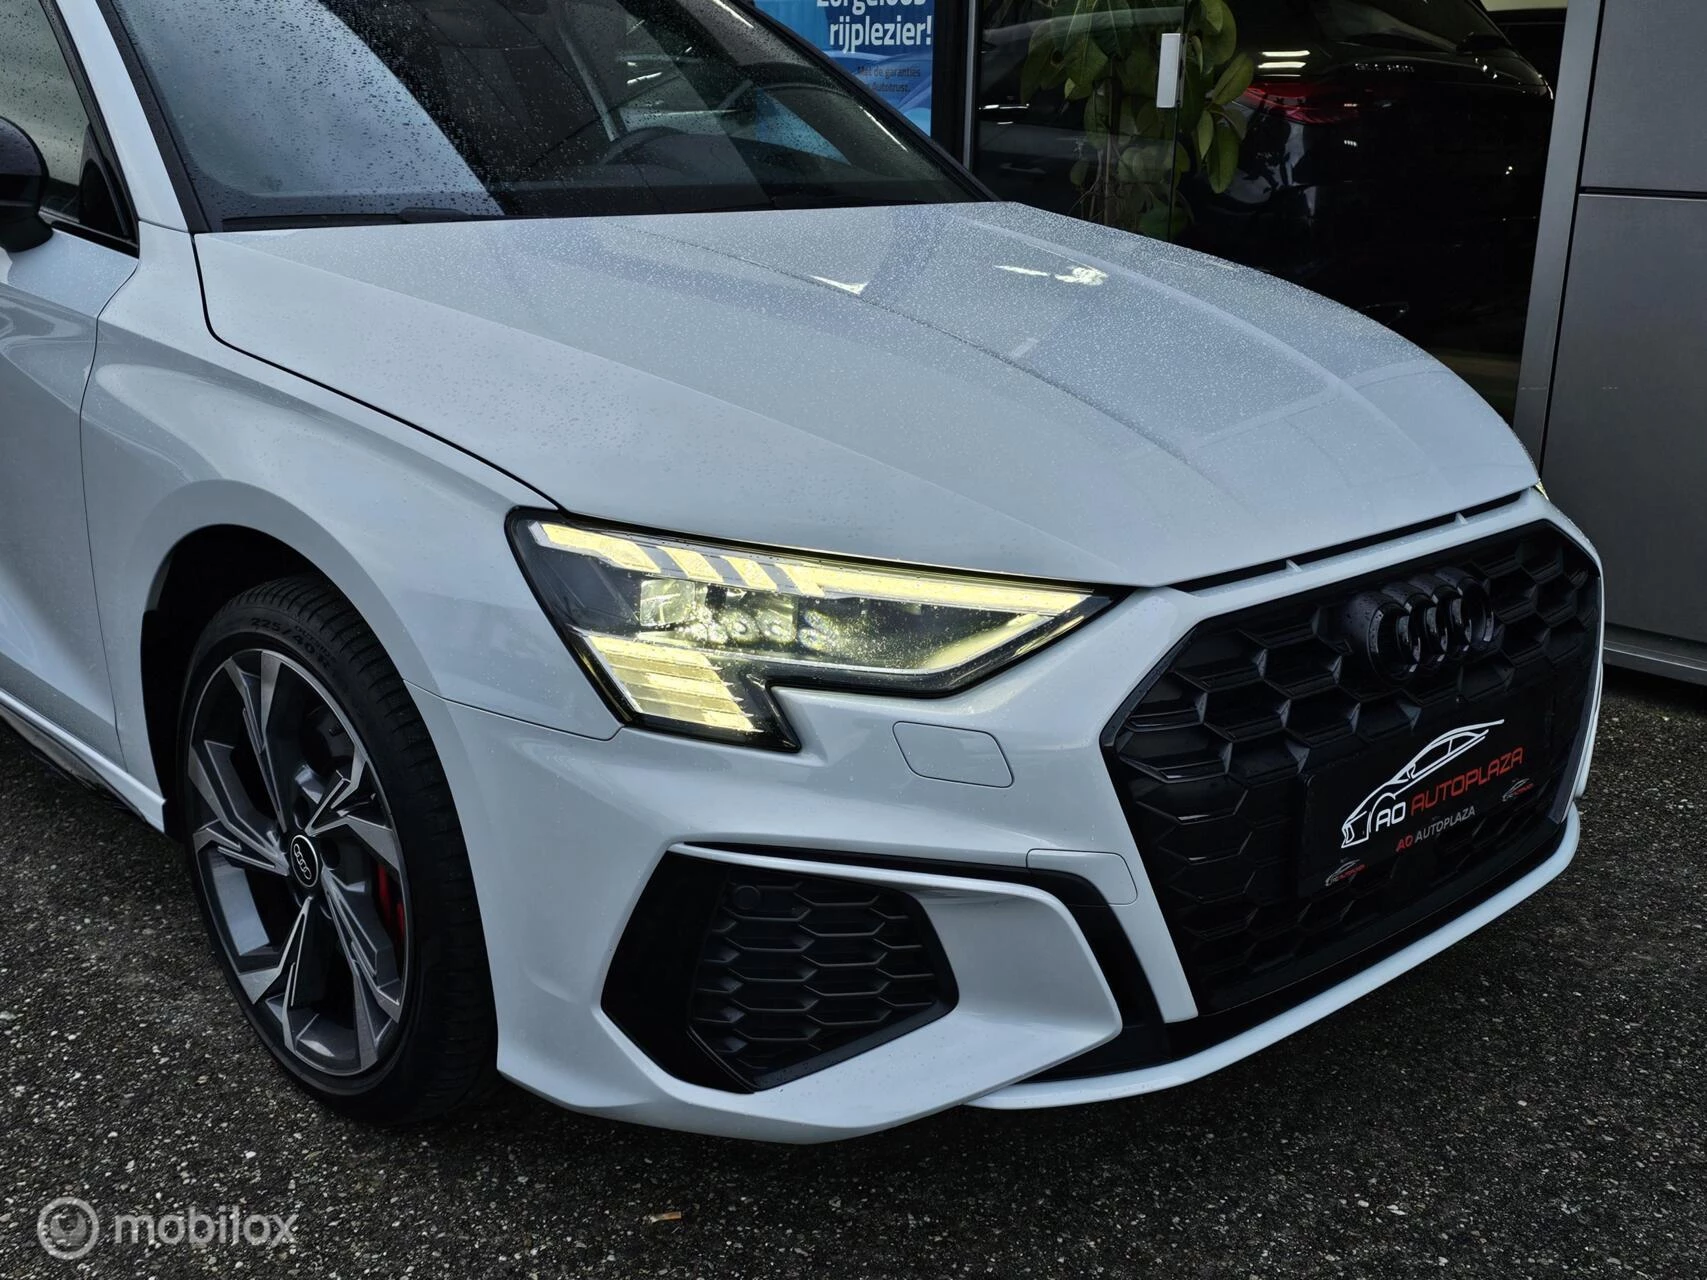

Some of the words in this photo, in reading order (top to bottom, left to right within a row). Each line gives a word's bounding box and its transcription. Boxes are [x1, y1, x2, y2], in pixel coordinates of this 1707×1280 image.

[830, 15, 932, 54] rijplezier!
[1410, 747, 1525, 817] AUTOPLAZA
[1415, 805, 1476, 843] AUTOPLAZA
